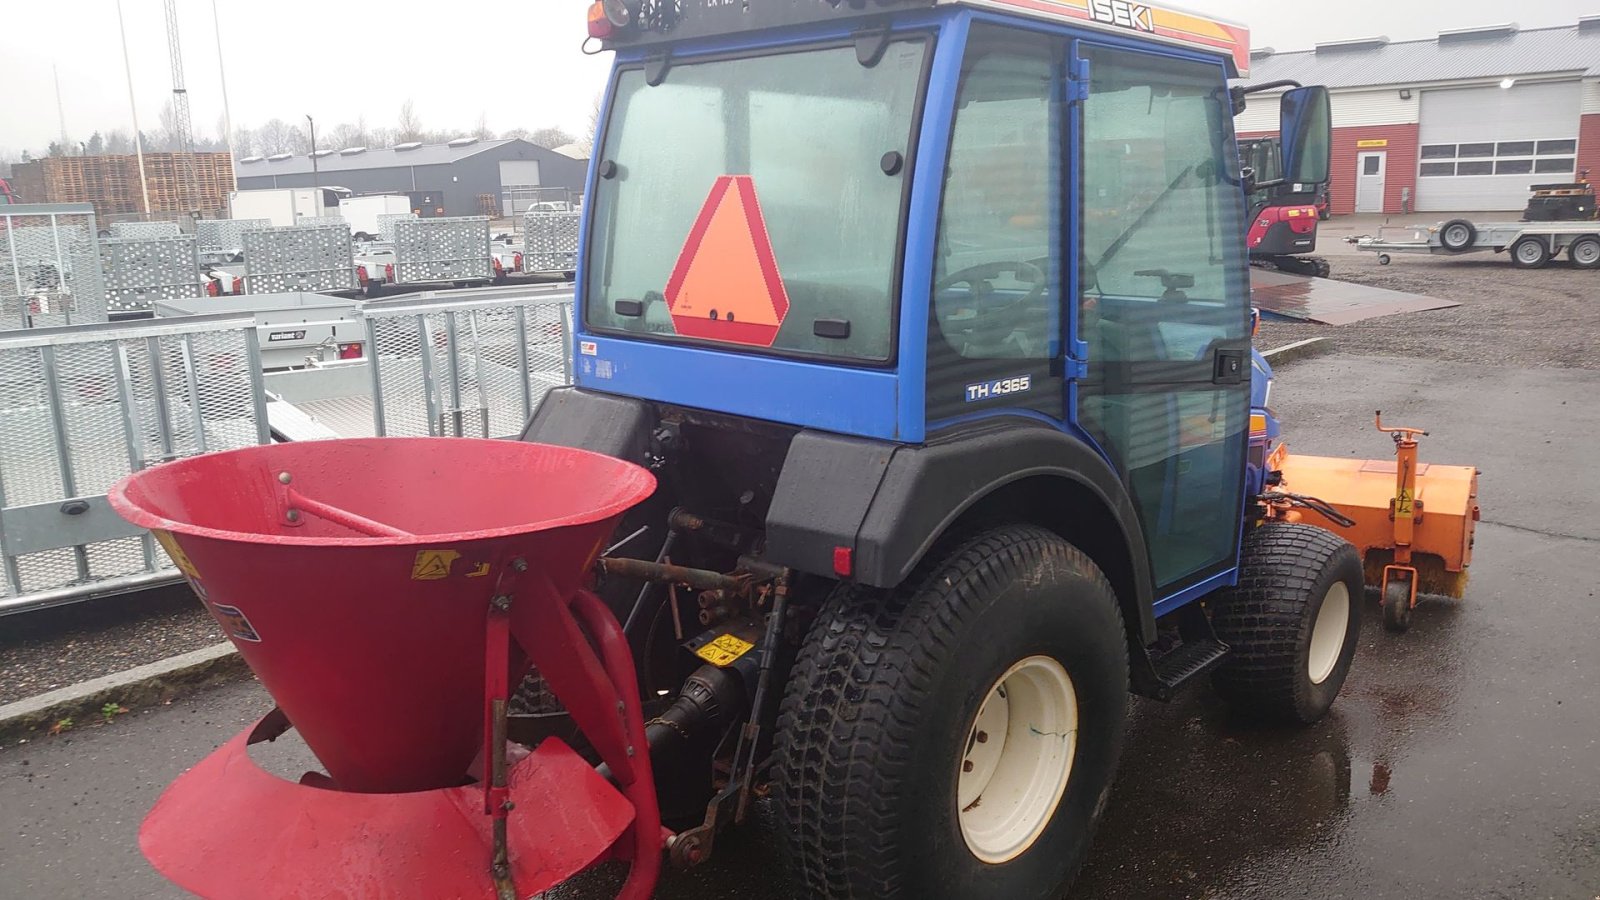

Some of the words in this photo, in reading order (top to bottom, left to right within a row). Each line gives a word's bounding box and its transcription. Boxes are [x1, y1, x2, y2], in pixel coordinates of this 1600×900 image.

[1087, 0, 1154, 32] ISEKI
[968, 384, 989, 400] TH
[991, 376, 1030, 395] 4365
